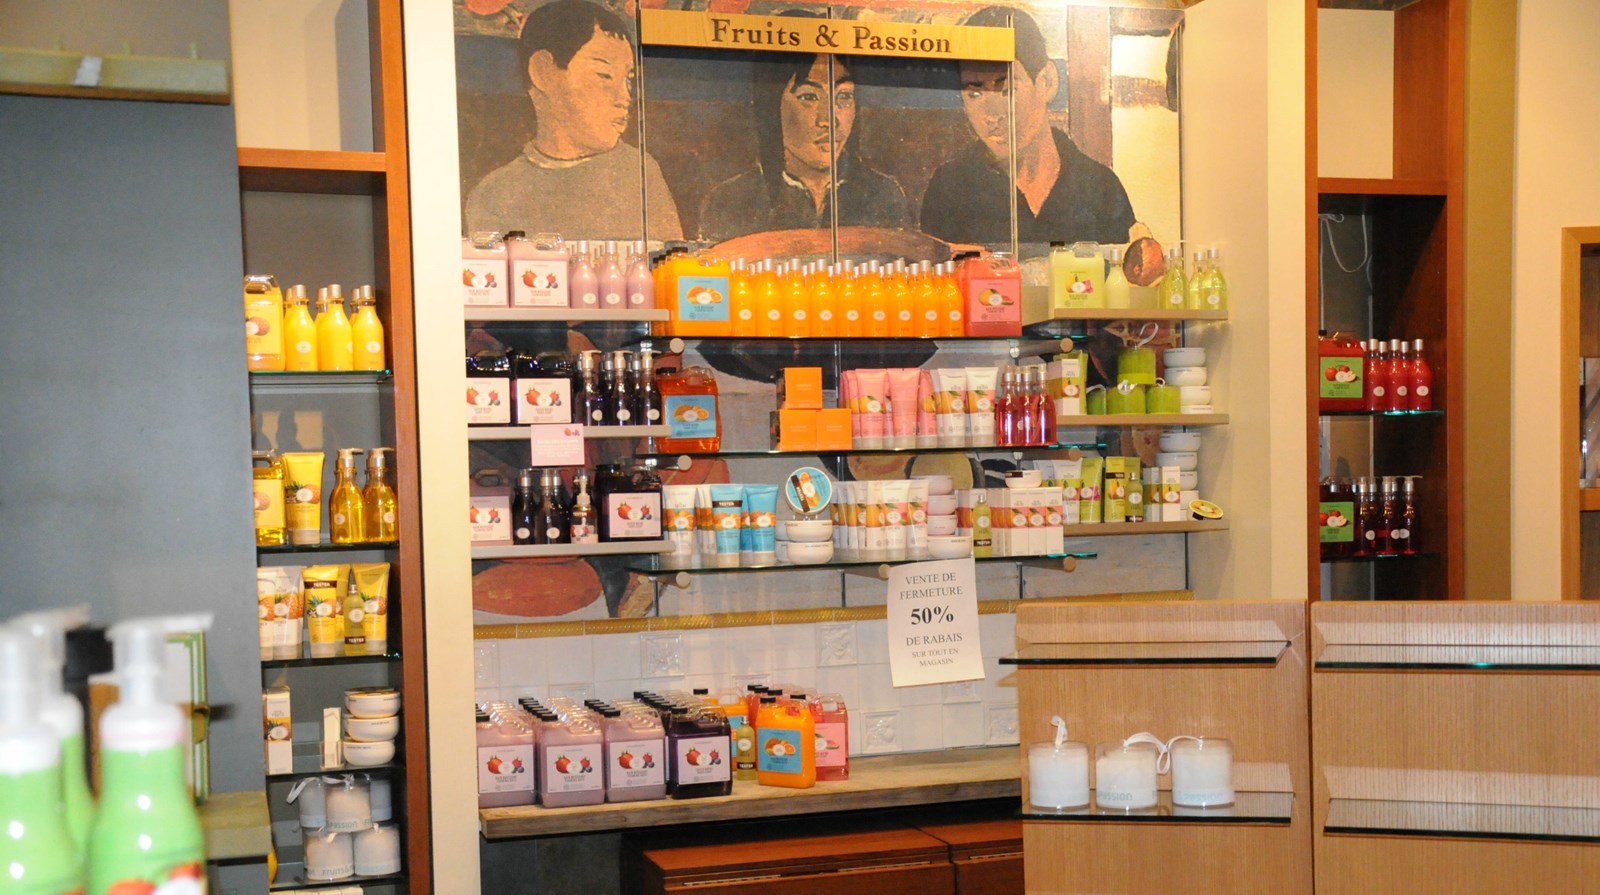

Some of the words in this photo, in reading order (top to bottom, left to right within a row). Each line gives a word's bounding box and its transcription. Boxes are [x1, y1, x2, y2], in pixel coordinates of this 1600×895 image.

[711, 18, 801, 46] Fruits
[815, 24, 839, 48] &
[852, 25, 952, 54] Passion
[905, 574, 940, 585] VENTE
[942, 573, 956, 582] DE
[900, 586, 963, 600] FERMETURE
[910, 605, 954, 625] 50%
[906, 636, 921, 646] DE
[923, 632, 963, 645] RABAIS
[911, 650, 927, 658] SUR
[928, 649, 947, 657] TOUT
[948, 647, 959, 655] EN
[919, 658, 954, 667] MAGASIN
